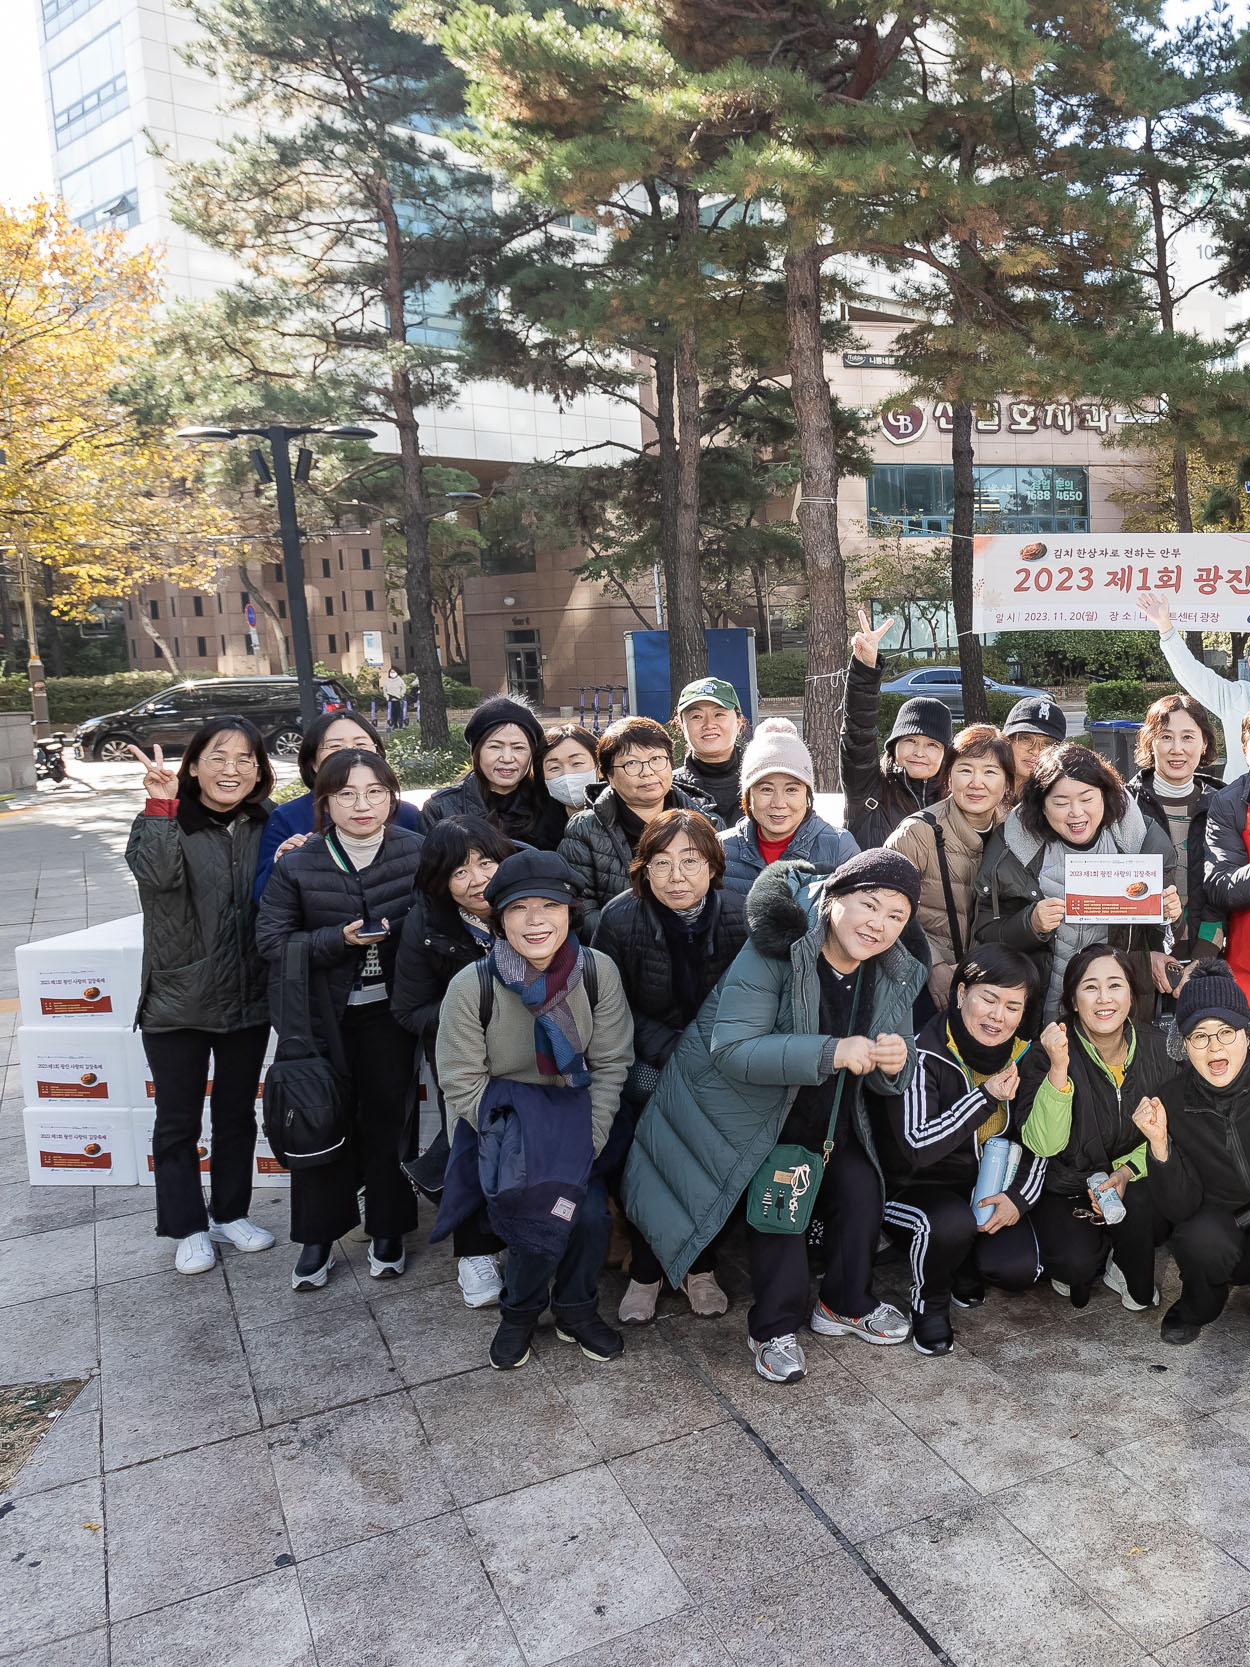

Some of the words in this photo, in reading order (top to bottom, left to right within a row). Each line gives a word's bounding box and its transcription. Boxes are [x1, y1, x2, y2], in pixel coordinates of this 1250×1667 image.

[1027, 490, 1051, 501] 1688
[1056, 491, 1083, 501] 4650
[1053, 548, 1073, 559] 김치
[1076, 548, 1120, 559] 한상자로
[1123, 548, 1156, 559] 전하는
[1159, 548, 1182, 559] 안부
[1013, 566, 1094, 593] 2023
[1103, 564, 1183, 594] 제1회
[1024, 611, 1050, 622] 2023.
[1054, 611, 1067, 622] 11.
[1069, 610, 1098, 622] 20(월)
[1139, 611, 1197, 622] 나트센터
[1199, 612, 1220, 623] 광장
[1083, 870, 1099, 878] 제1회
[1100, 870, 1113, 878] 광진
[1113, 870, 1132, 878] 사랑의
[1133, 870, 1157, 878] 김장축제
